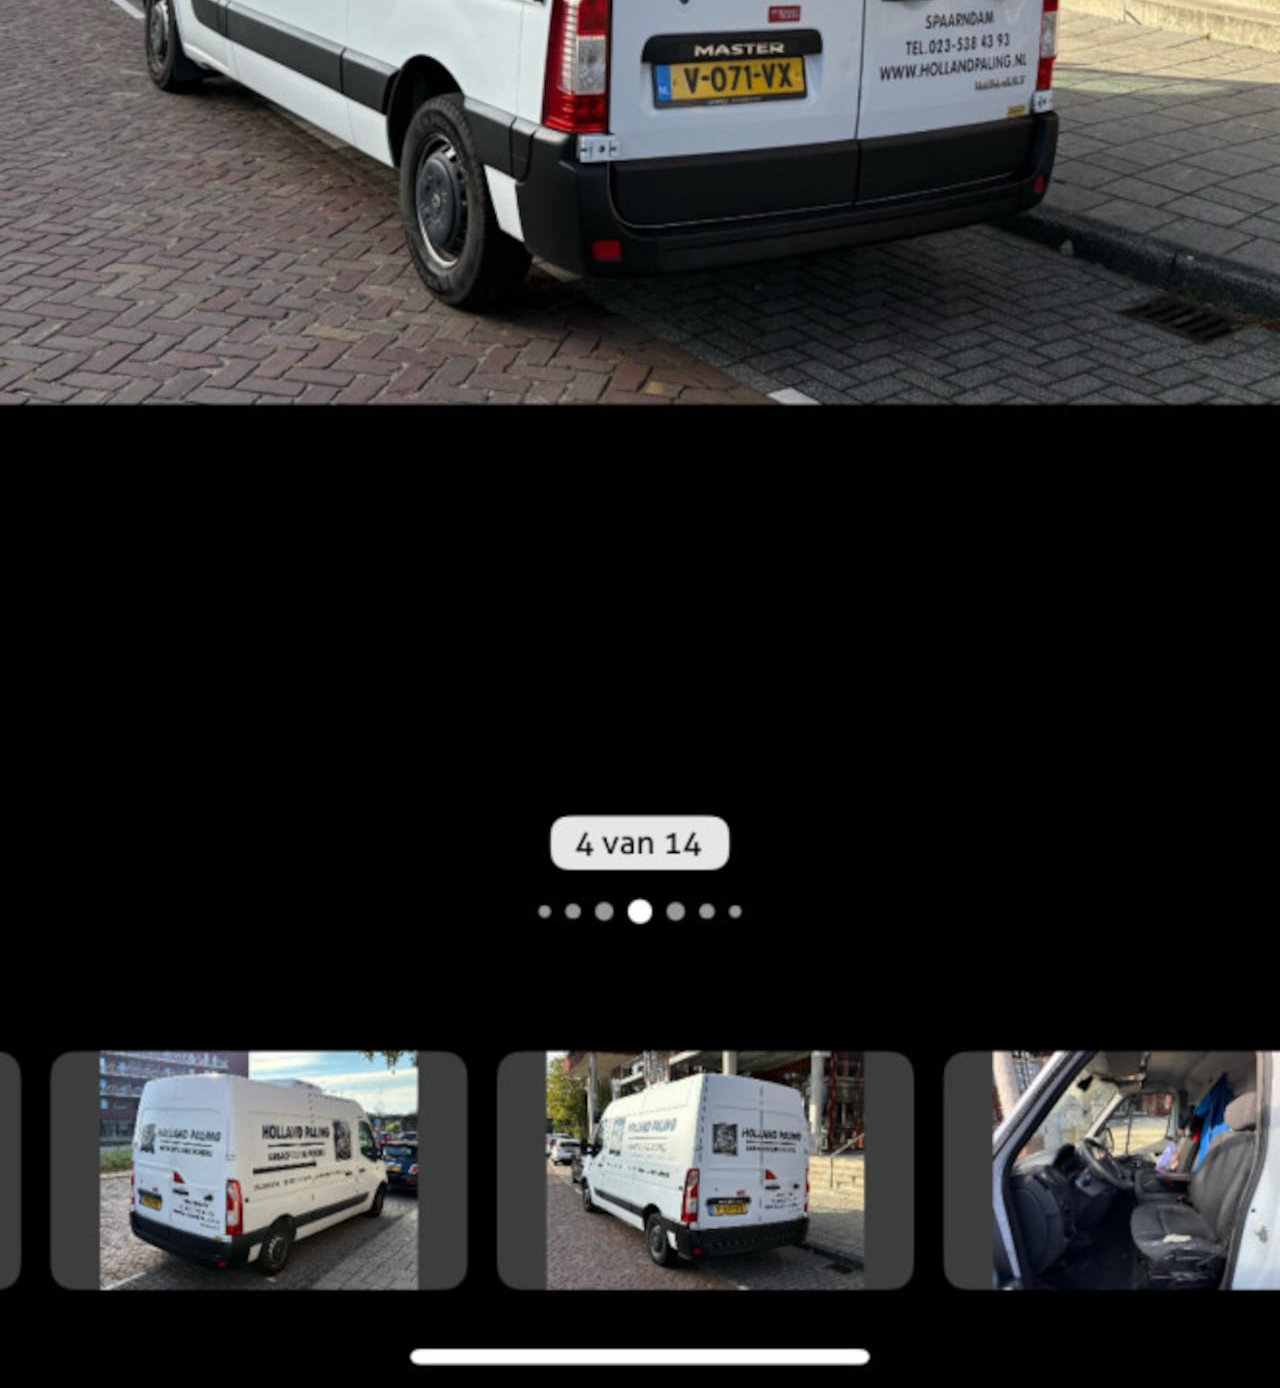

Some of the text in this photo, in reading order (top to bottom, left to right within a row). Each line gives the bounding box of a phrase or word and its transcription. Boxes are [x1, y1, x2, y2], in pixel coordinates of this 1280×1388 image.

[925, 10, 994, 29] SPAARNDAM
[694, 41, 785, 57] MASTER
[981, 33, 994, 49] 43
[997, 32, 1011, 48] 93
[880, 52, 1027, 81] WWW.HOLLANDPALING.NL
[683, 63, 793, 94] V-071-VX
